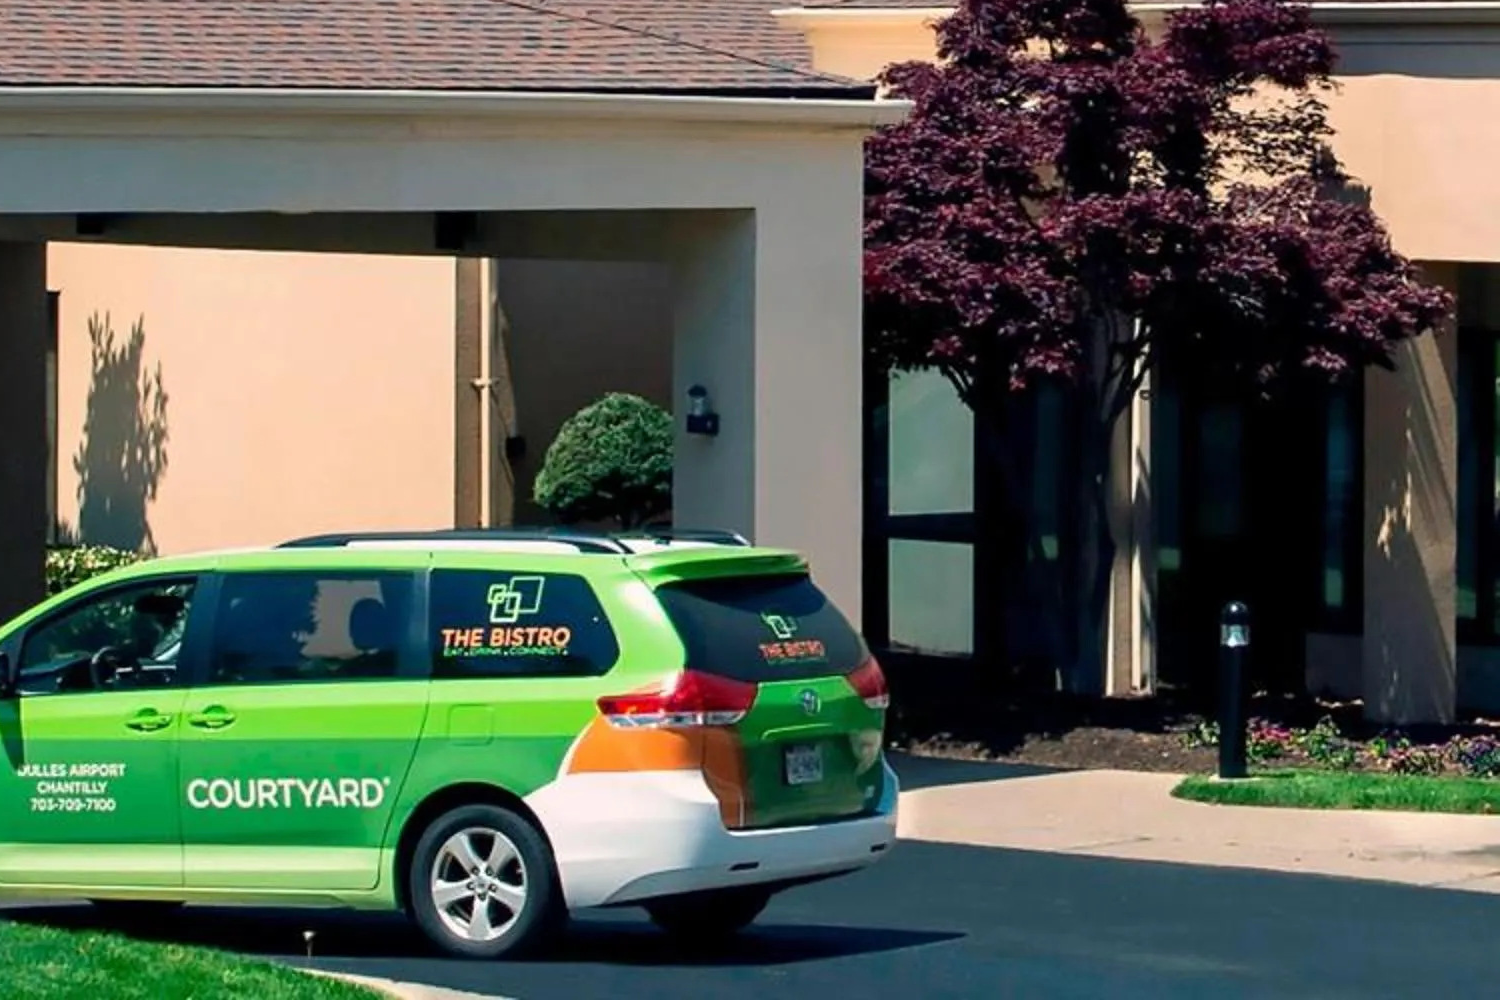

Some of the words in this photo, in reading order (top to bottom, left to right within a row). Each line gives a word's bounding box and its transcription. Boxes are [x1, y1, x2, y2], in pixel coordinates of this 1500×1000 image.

[441, 628, 485, 647] THE
[489, 626, 571, 648] BISTRO
[69, 763, 126, 777] AIRPORT
[36, 780, 108, 795] CHANTILLY
